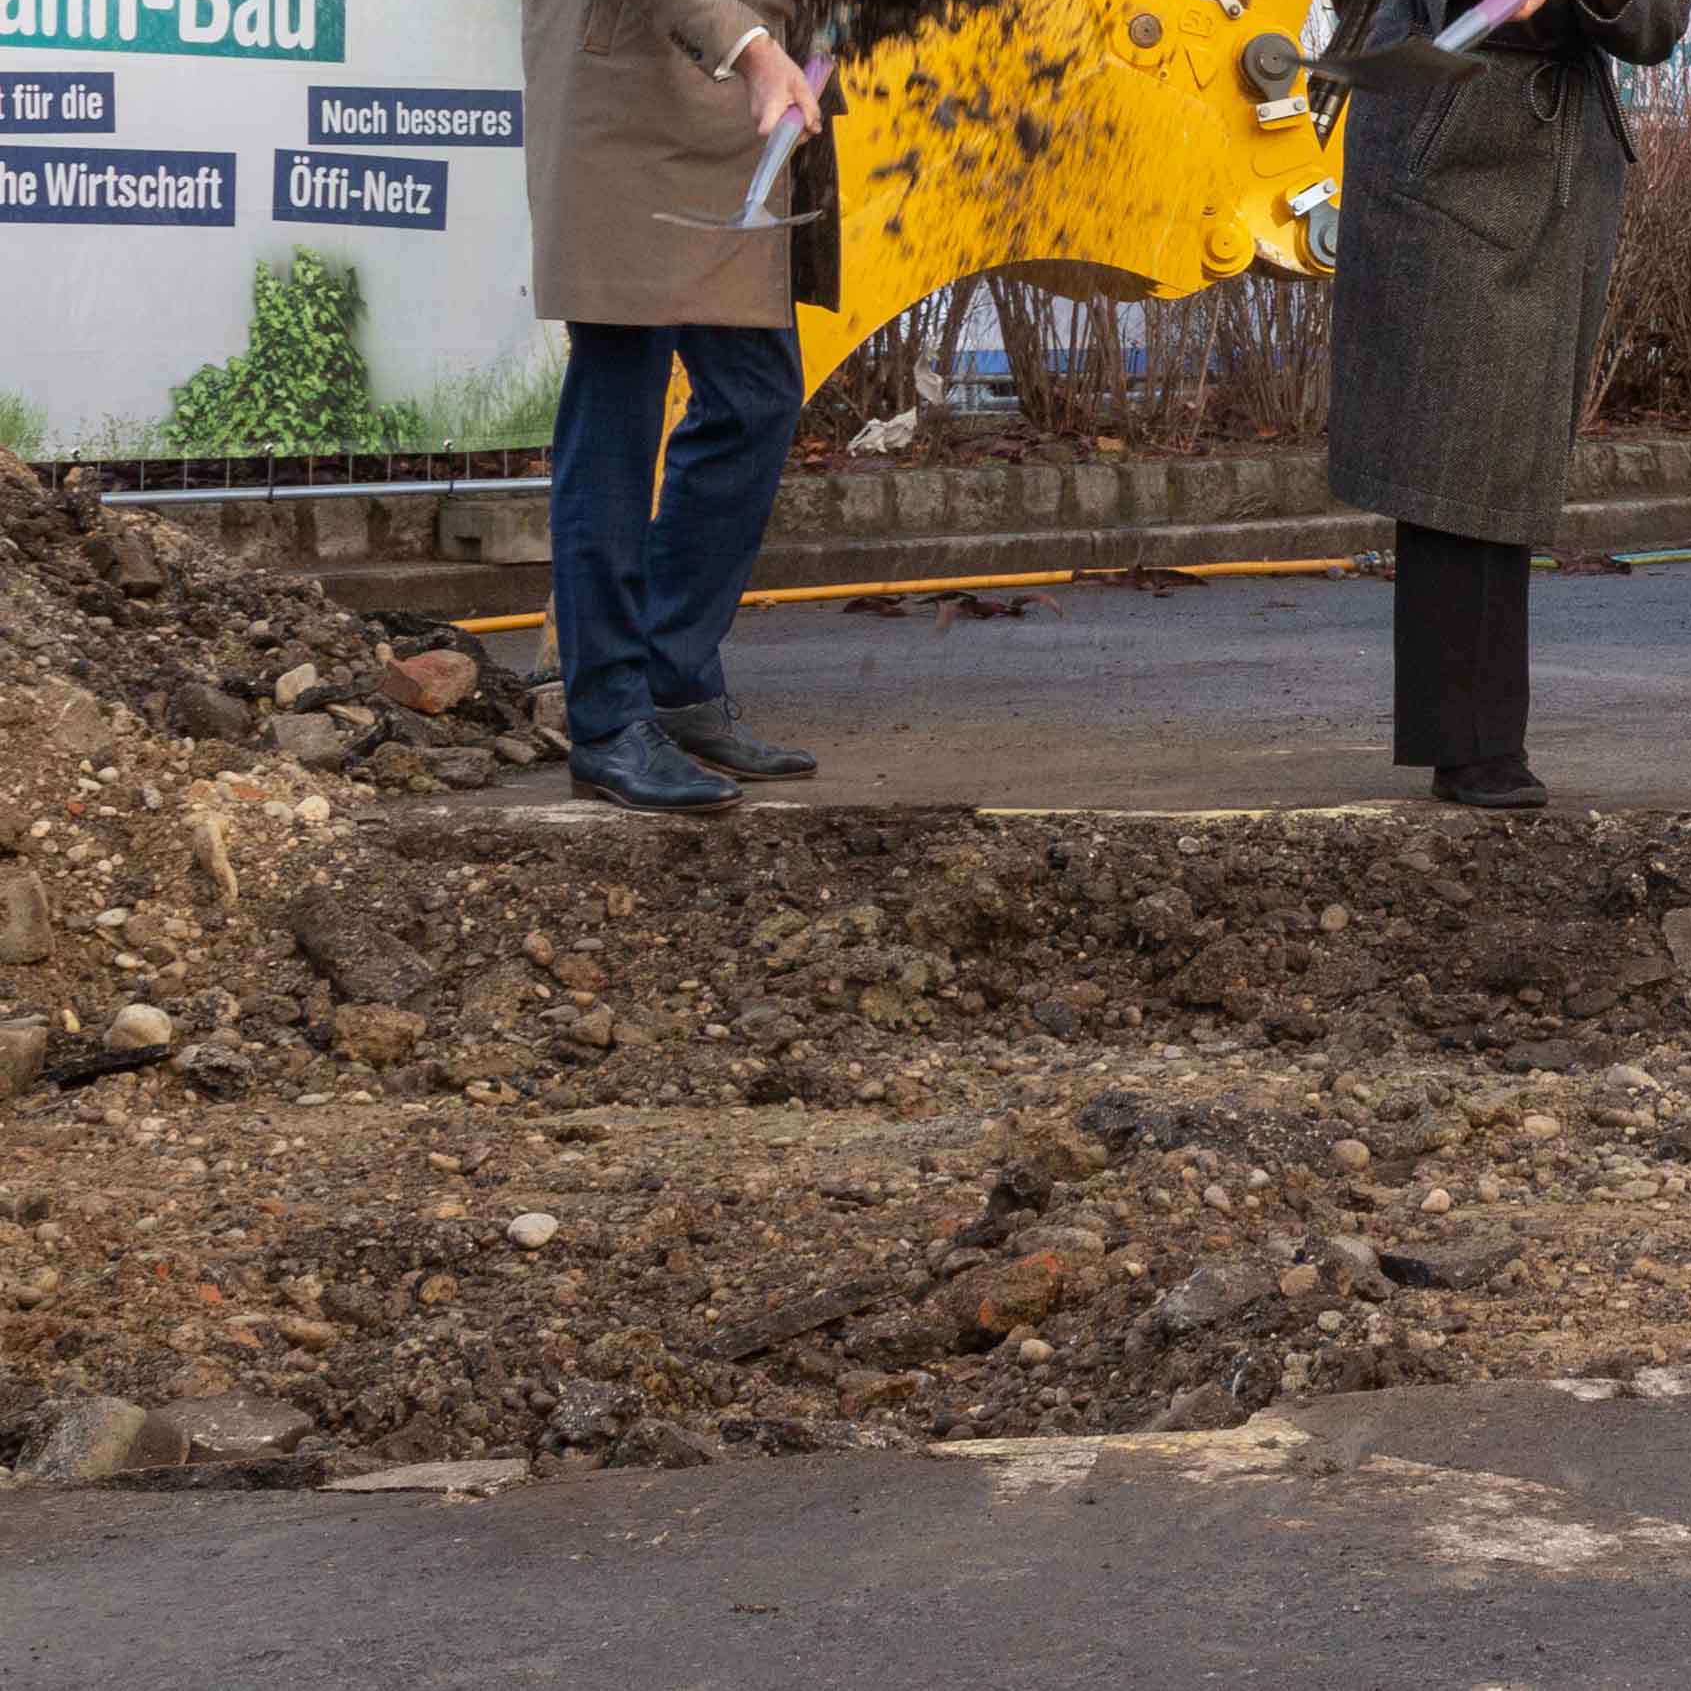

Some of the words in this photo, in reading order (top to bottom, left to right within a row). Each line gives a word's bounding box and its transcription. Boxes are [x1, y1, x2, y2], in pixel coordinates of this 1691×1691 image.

[12, 84, 54, 120] für
[61, 84, 104, 120] die
[321, 99, 387, 135] Noch
[396, 101, 512, 136] besseres
[44, 162, 223, 210] Wirtschaft
[289, 155, 433, 215] Öffi-Netz
